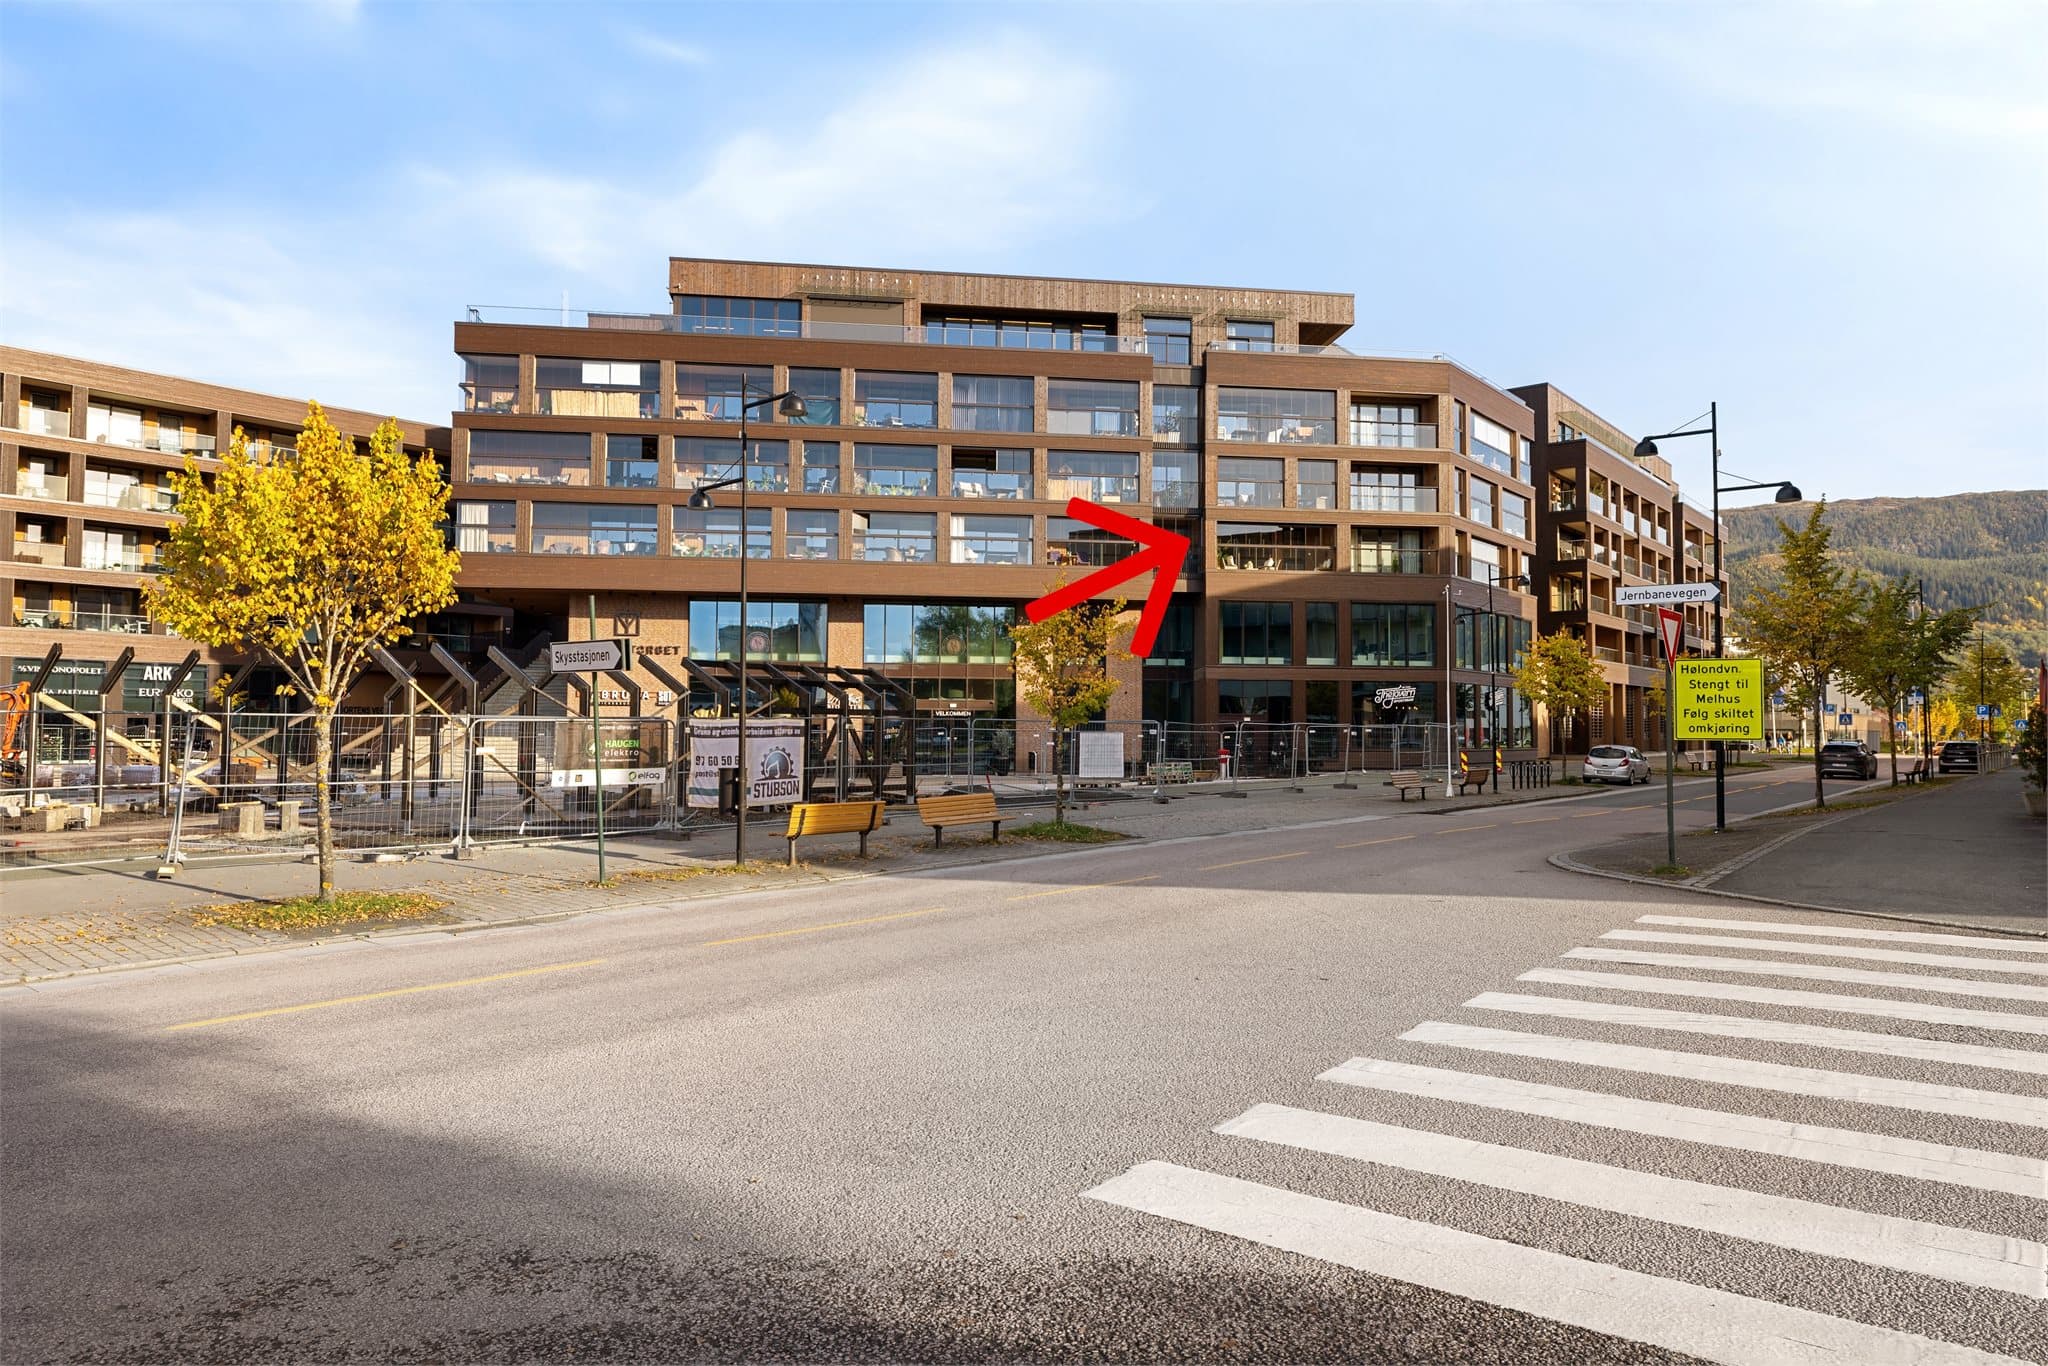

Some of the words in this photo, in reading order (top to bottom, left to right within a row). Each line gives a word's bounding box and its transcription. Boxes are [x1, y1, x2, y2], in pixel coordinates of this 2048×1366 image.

[1621, 587, 1707, 601] Jernbanevegen
[631, 645, 681, 656] TORGET
[554, 649, 610, 666] Skysstasjonen
[143, 665, 172, 681] ARK
[1689, 679, 1730, 691] Stengt
[1736, 679, 1749, 689] til
[1696, 694, 1741, 704] Melhus
[1683, 708, 1709, 720] Følg
[1714, 708, 1754, 719] skiltet
[1978, 706, 1987, 714] P
[1688, 723, 1750, 735] omkjøring
[604, 739, 640, 748] HAUGEN
[604, 748, 639, 757] elektro
[695, 755, 705, 766] 97
[708, 755, 719, 767] 60
[721, 755, 731, 766] 50
[753, 780, 801, 799] STUBSON
